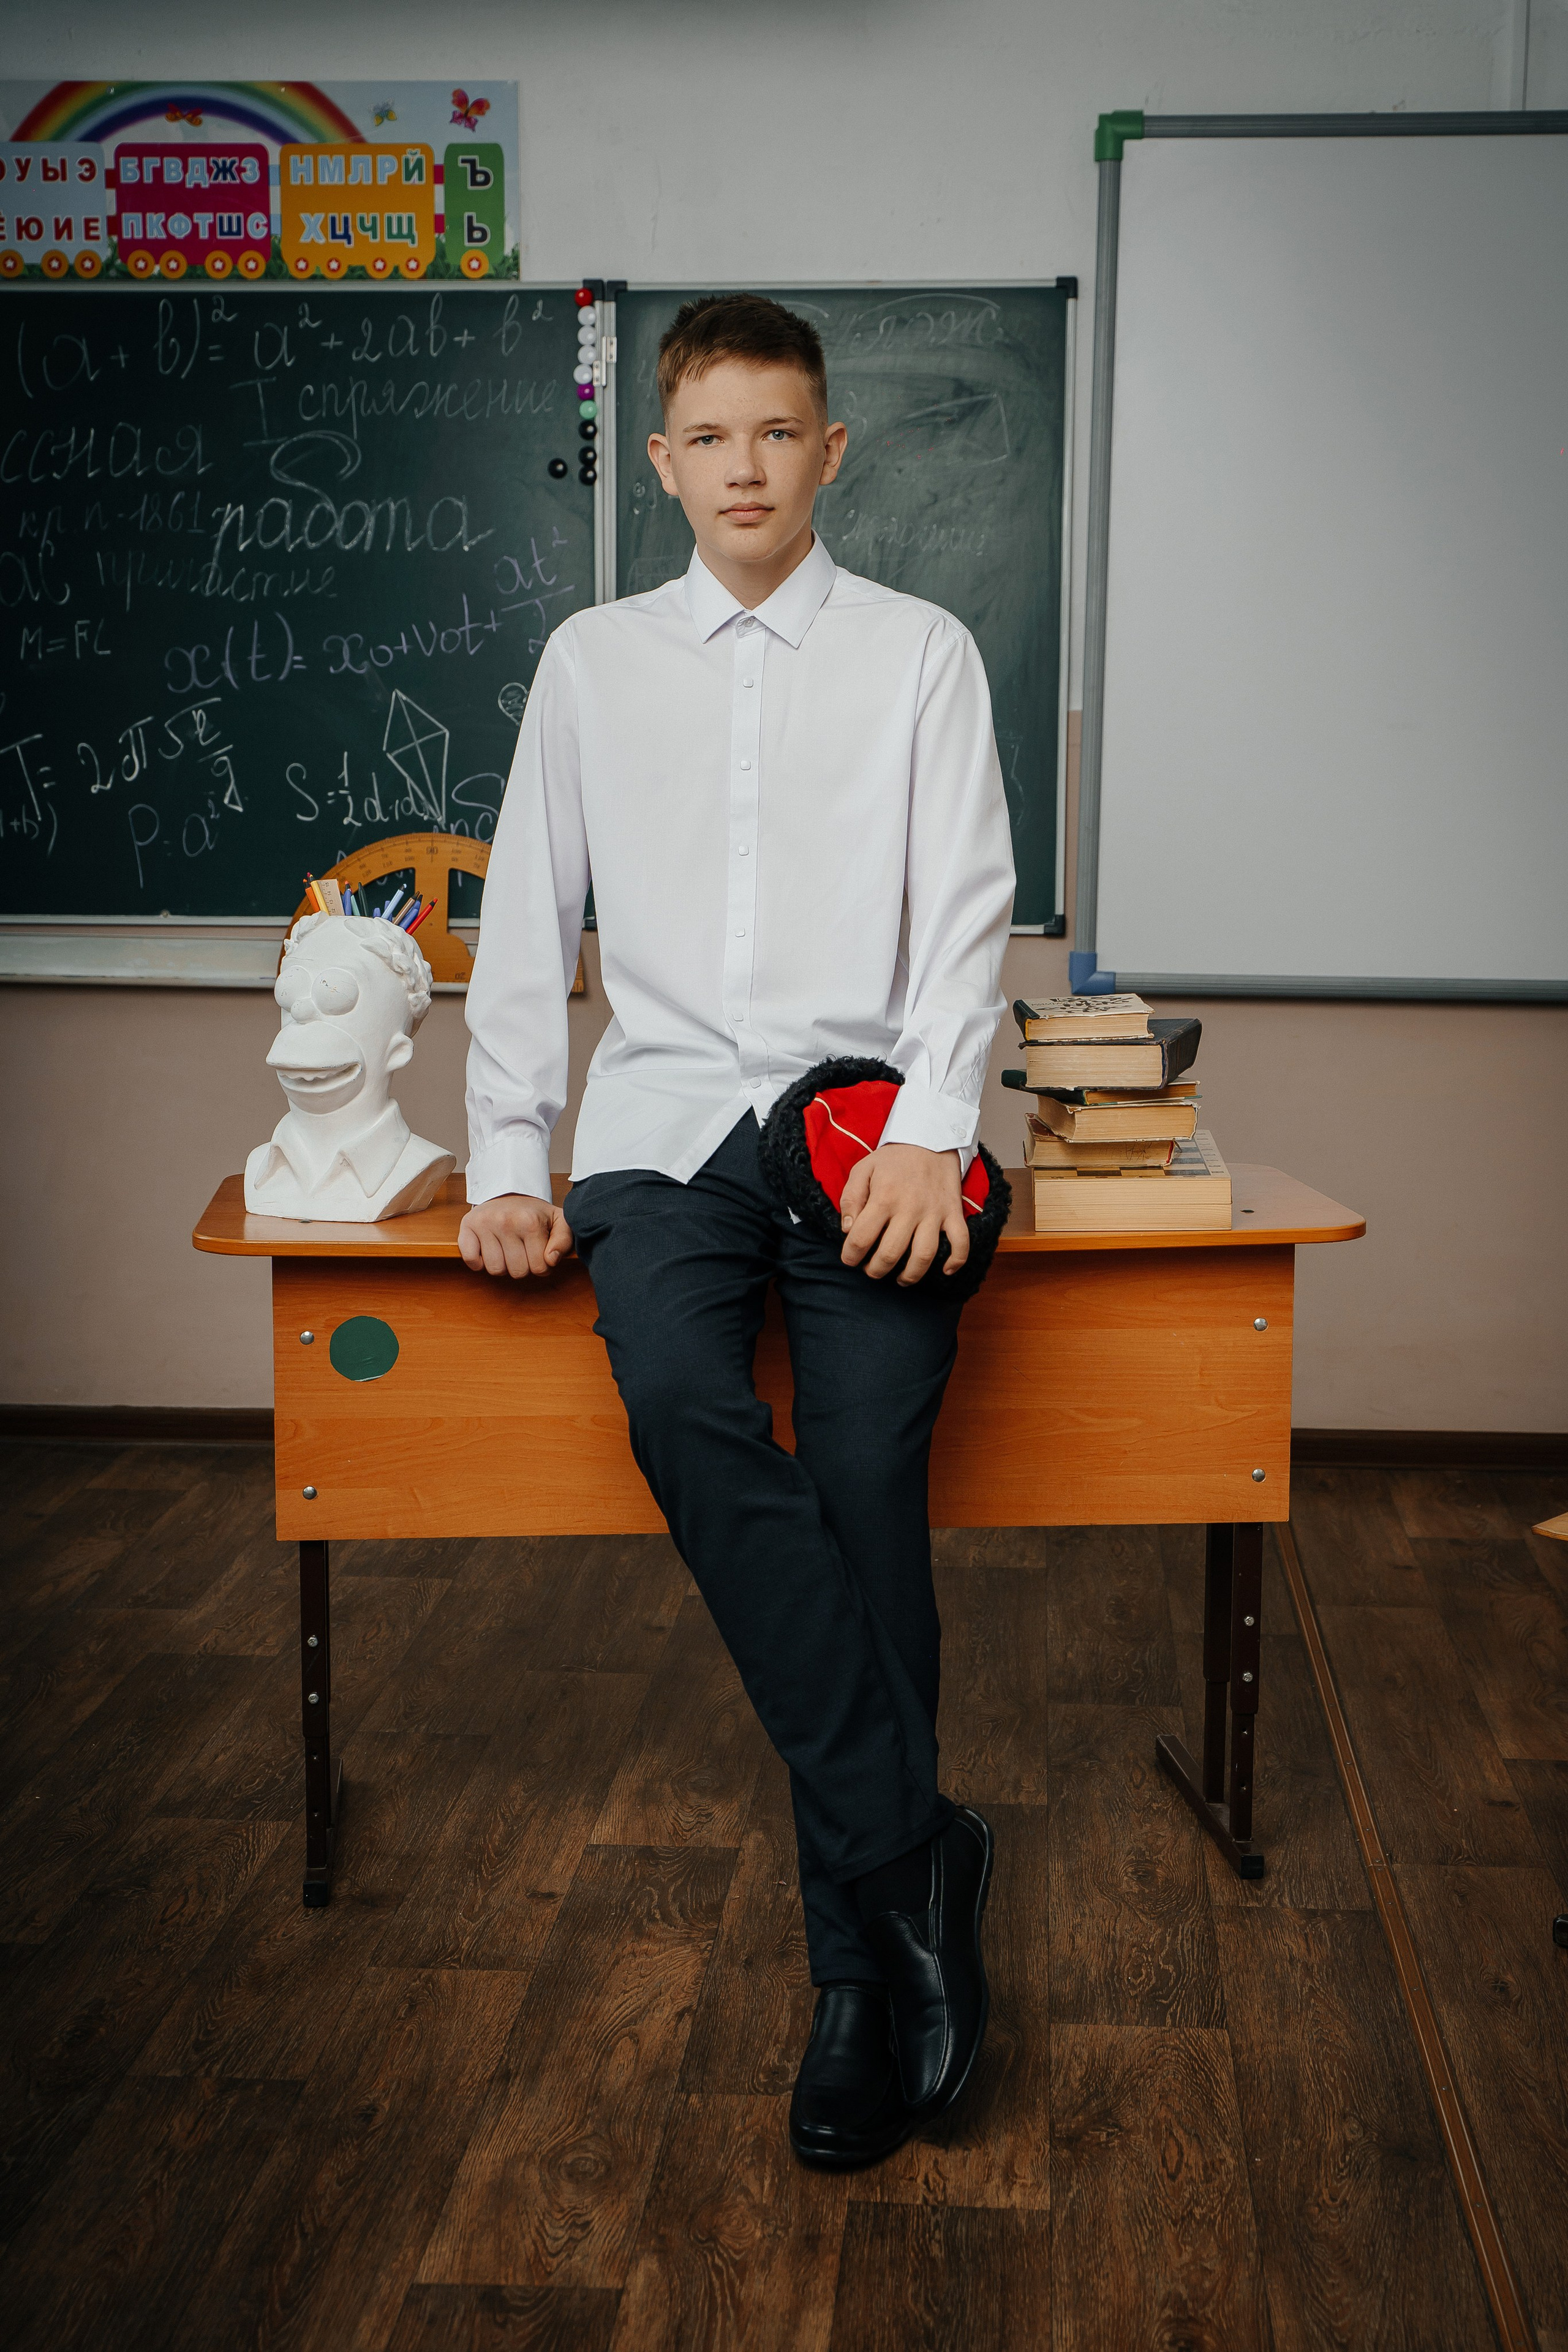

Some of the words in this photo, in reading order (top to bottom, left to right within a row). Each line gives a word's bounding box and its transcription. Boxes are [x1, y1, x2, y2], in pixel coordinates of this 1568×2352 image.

[119, 157, 258, 187] БГВДЖЗ
[290, 149, 426, 184] НМЛРЙ
[458, 156, 494, 190] Ъ
[121, 213, 268, 239] ПКФТШС
[300, 213, 418, 248] ХЦЧЩ
[464, 212, 491, 246] Ь
